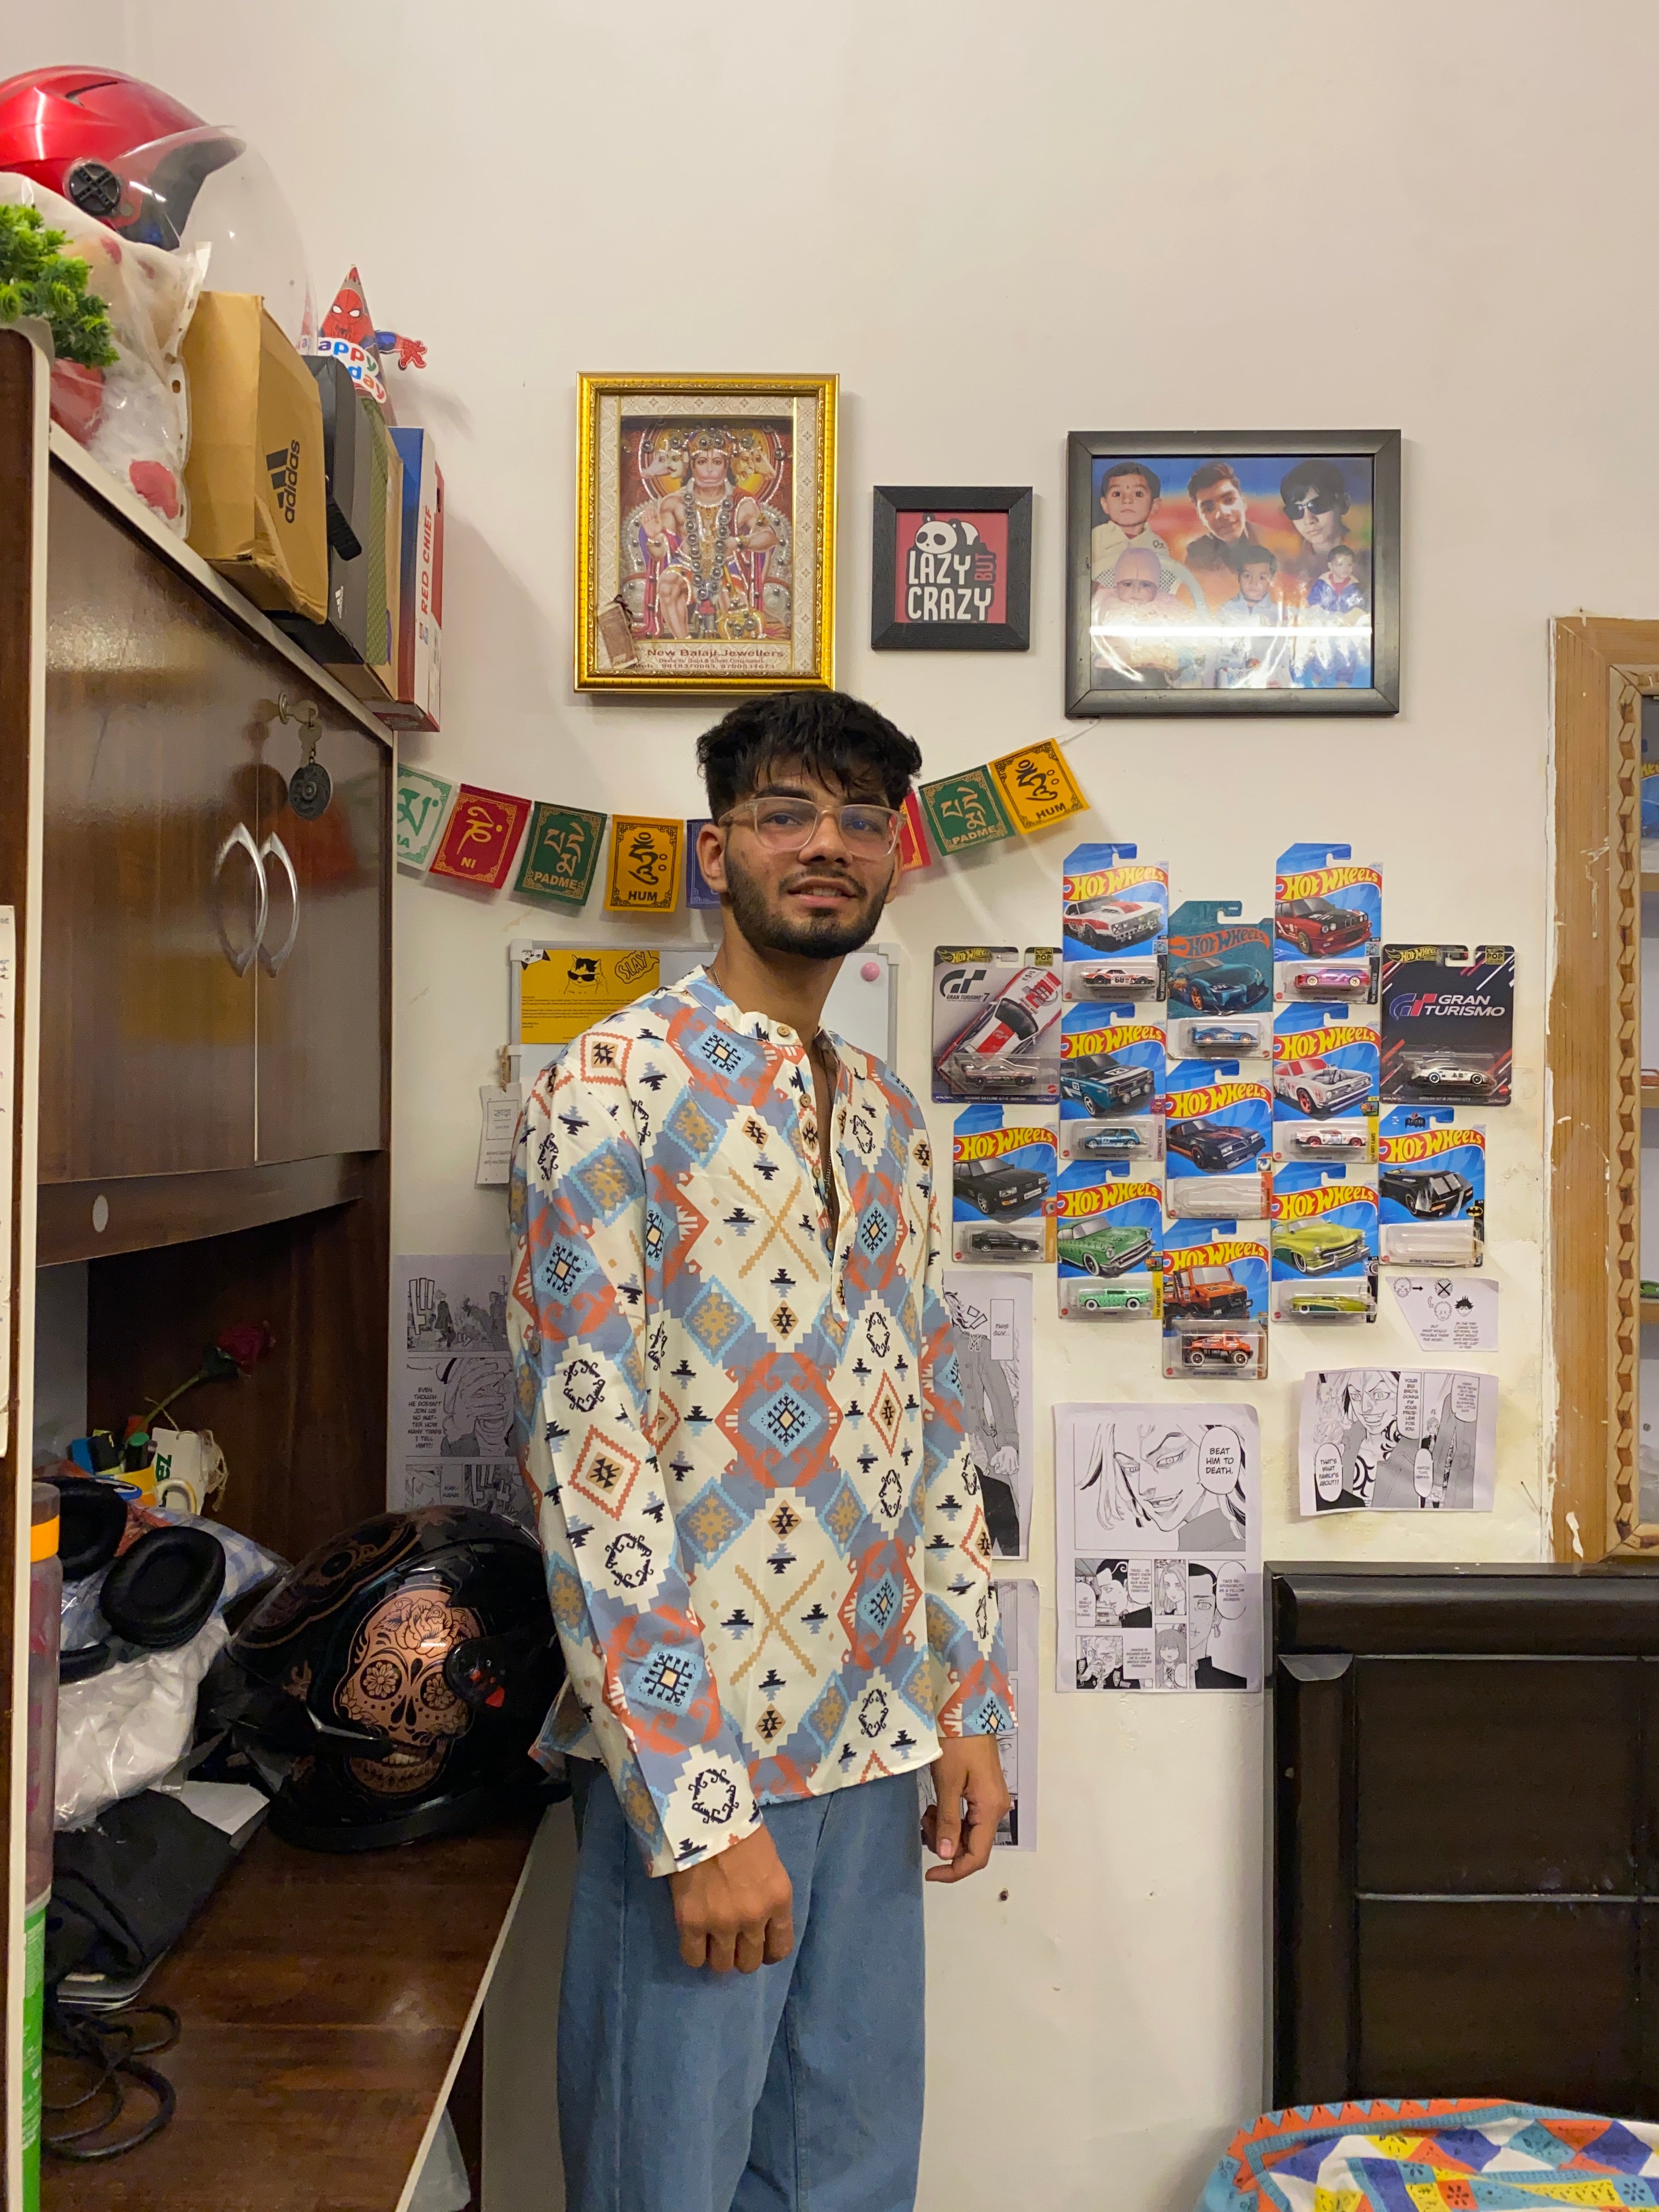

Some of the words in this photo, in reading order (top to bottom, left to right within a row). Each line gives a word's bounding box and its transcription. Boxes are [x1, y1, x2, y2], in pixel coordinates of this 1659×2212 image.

[284, 439, 300, 523] adidas
[423, 505, 433, 563] CHIEF
[909, 550, 971, 585] LAZY
[974, 553, 994, 581] BUT
[421, 573, 430, 615] RED
[908, 586, 991, 620] CRAZY
[680, 650, 716, 658] Balaji
[1036, 802, 1066, 820] HUM
[952, 825, 997, 844] PADME
[461, 857, 476, 868] NI
[534, 871, 578, 889] PADME
[628, 891, 657, 901] HUM
[618, 951, 647, 980] SLAY
[983, 993, 990, 1002] 7
[1438, 995, 1491, 1005] GRAN
[1425, 1006, 1505, 1016] TURISMO
